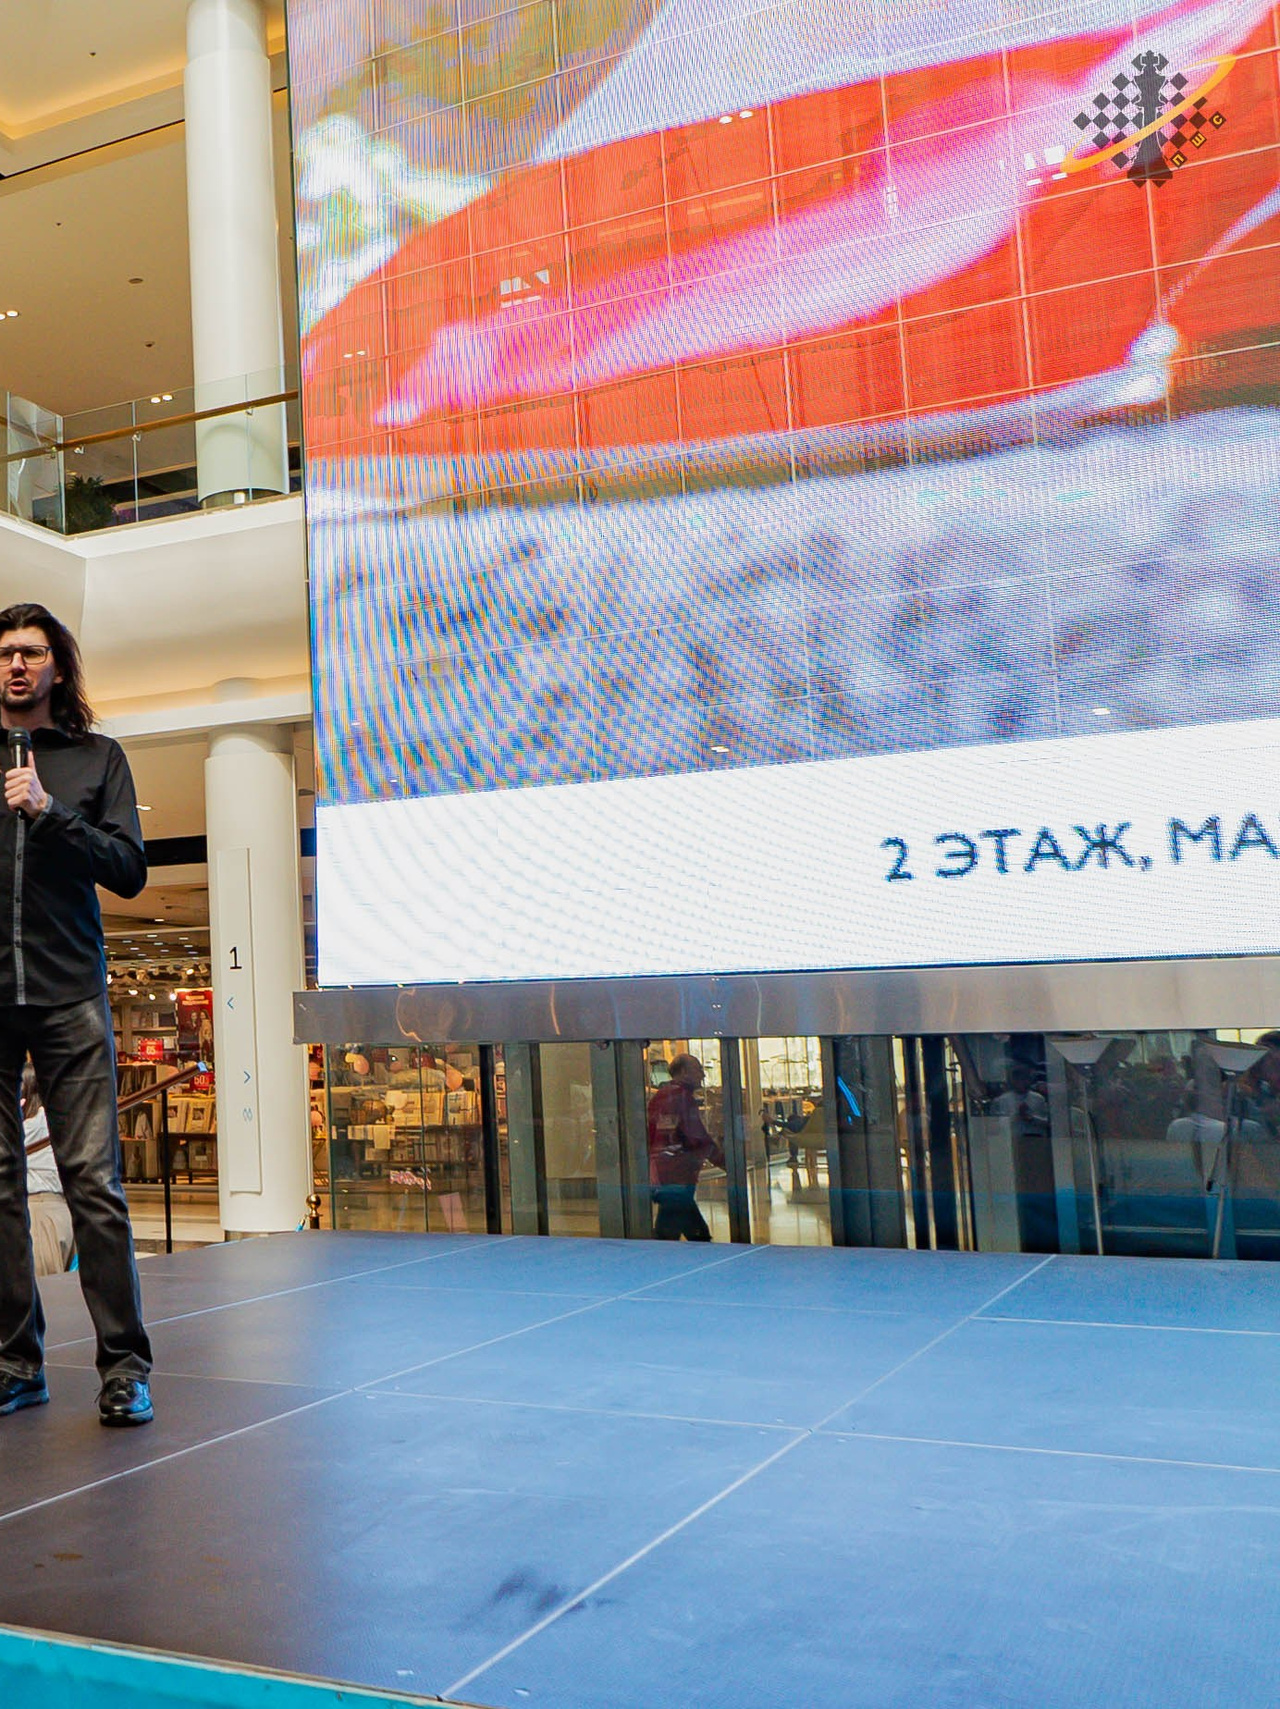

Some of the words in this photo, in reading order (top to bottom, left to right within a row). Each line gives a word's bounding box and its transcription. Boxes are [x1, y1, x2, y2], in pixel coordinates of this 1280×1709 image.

[880, 836, 914, 883] 2
[933, 821, 1152, 879] ЭТАЖ,
[1170, 811, 1280, 864] МА
[229, 946, 243, 970] 1
